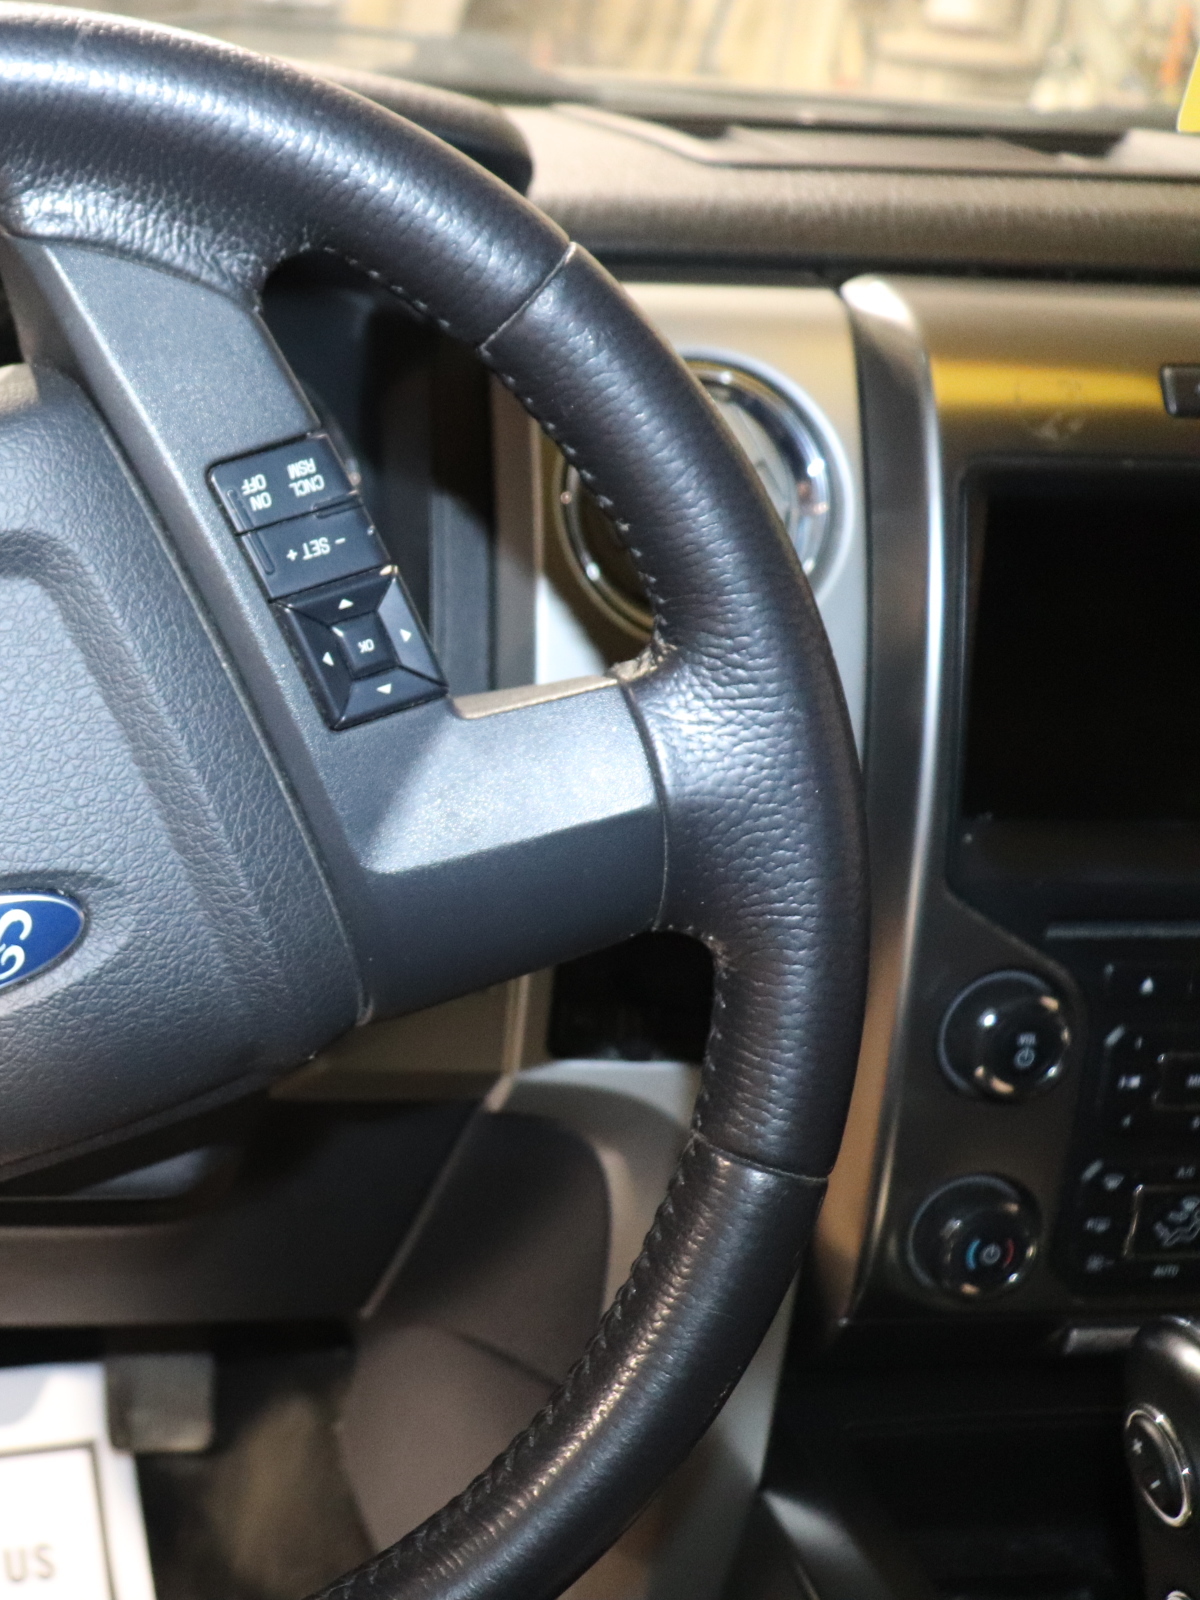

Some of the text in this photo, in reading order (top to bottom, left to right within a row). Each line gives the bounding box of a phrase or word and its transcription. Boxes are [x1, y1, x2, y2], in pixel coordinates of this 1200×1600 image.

[287, 458, 316, 480] RSM
[241, 474, 267, 495] OFF
[289, 474, 325, 498] CNCL
[250, 492, 272, 511] ON
[302, 537, 331, 560] SET
[358, 638, 375, 653] OK
[3, 1544, 56, 1584] US
